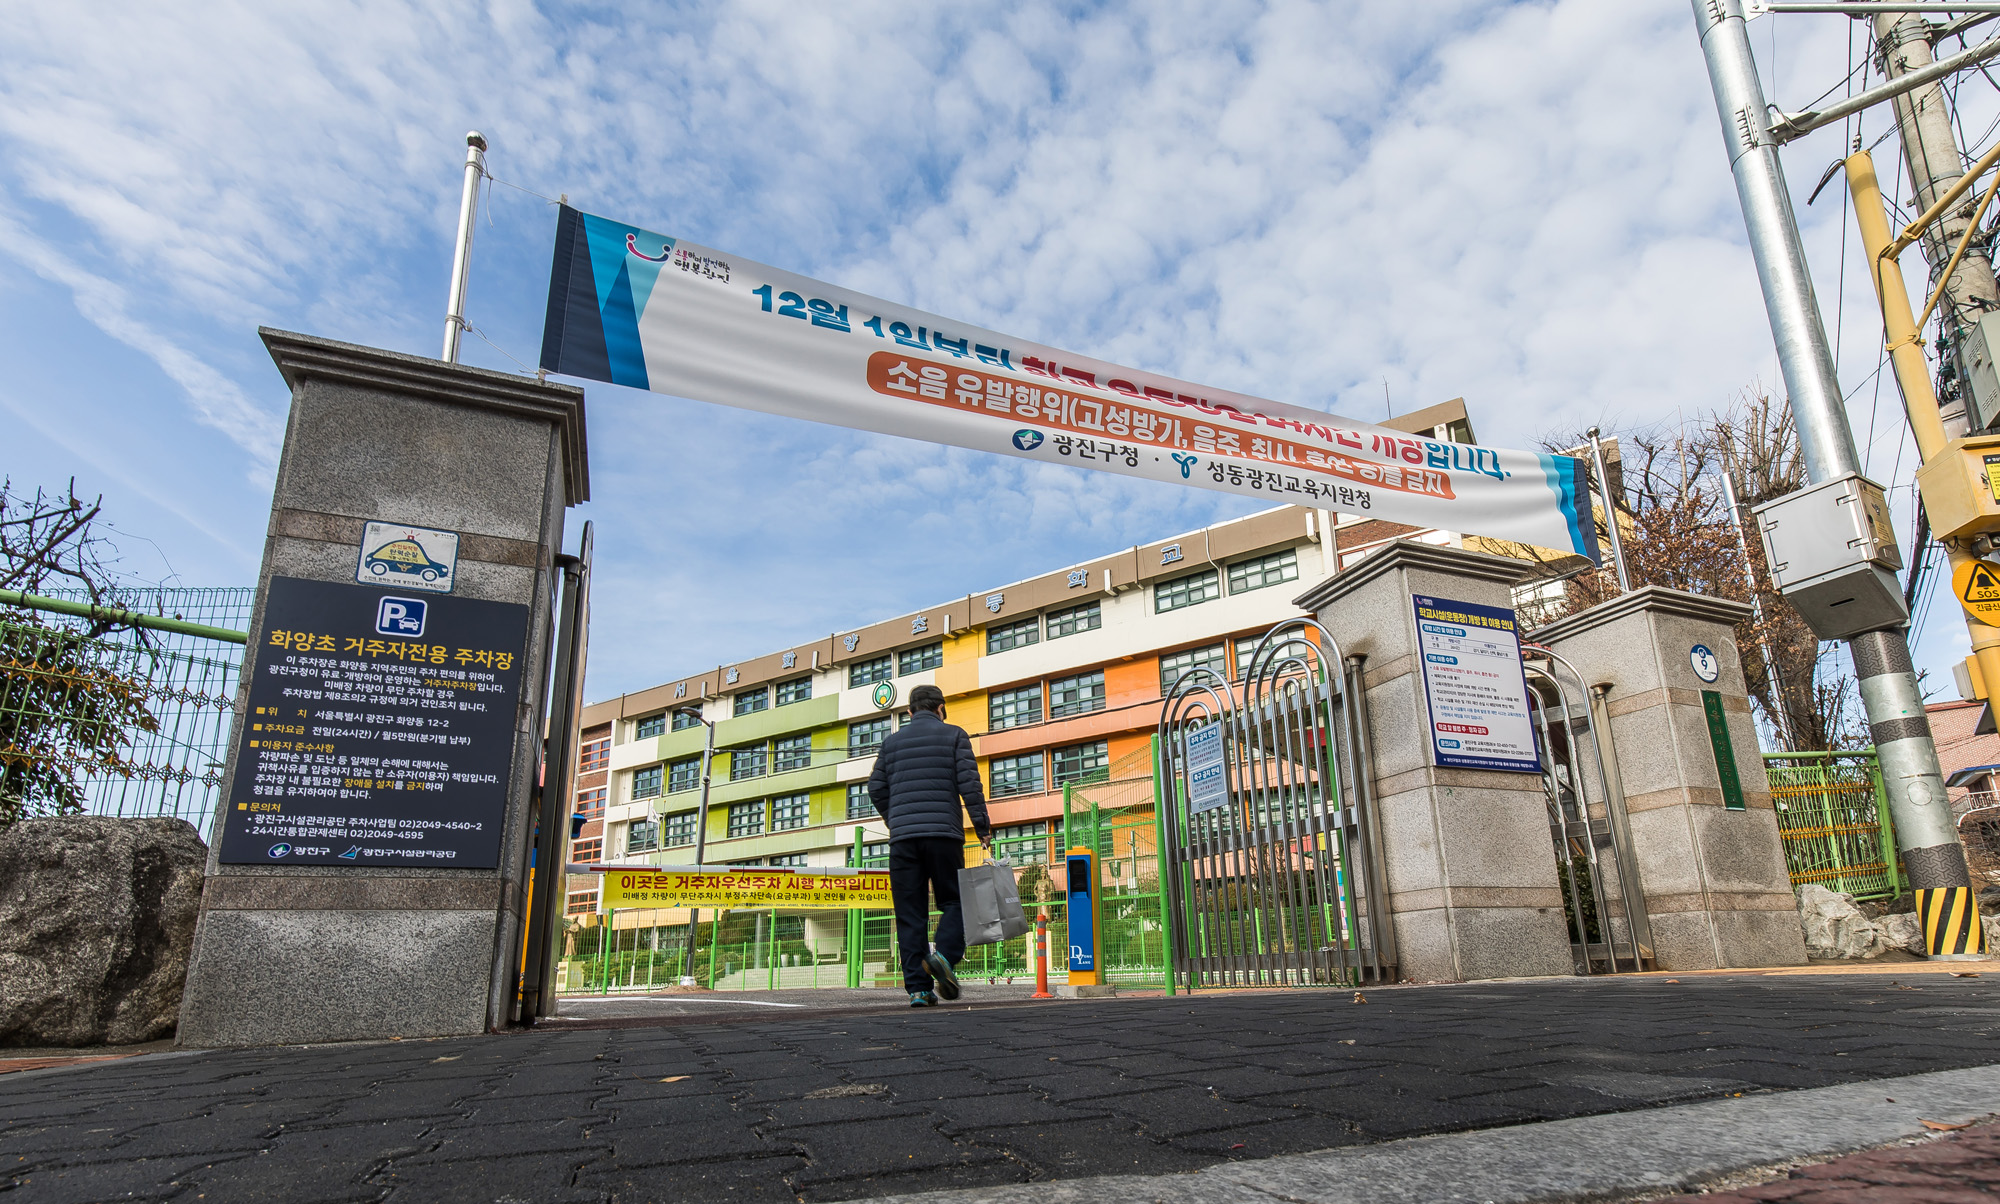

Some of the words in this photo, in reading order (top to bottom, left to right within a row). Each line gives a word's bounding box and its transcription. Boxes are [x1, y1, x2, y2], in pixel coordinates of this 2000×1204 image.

[674, 259, 730, 284] 행복광진
[752, 284, 851, 334] 12월
[886, 361, 948, 400] 소음
[954, 374, 1188, 448] 유발행위(고성방가,
[1193, 425, 1247, 458] 음주,
[1406, 468, 1445, 496] 금지
[1052, 434, 1138, 468] 광진구청
[1208, 461, 1371, 509] 성동광진교육지원청
[1977, 590, 2000, 598] SOS
[381, 602, 407, 628] P
[1488, 618, 1500, 628] 이용
[1501, 620, 1514, 630] 안내
[269, 630, 336, 652] 화양초
[344, 638, 448, 664] 거주자전용
[454, 648, 514, 670] 주차장
[286, 656, 296, 664] 이
[298, 656, 337, 668] 주차장은
[340, 660, 368, 672] 화양동
[371, 663, 416, 675] 지역주민의
[419, 667, 437, 677] 주차
[440, 670, 466, 680] 편의를
[469, 672, 494, 682] 위하여
[1701, 660, 1708, 670] 9
[269, 665, 318, 678] 광진구청이
[385, 675, 421, 686] 운영하는
[424, 679, 505, 693] 거주자주차장입니다.
[324, 680, 352, 692] 미배정
[355, 684, 384, 694] 차량이
[386, 685, 404, 696] 무단
[407, 687, 434, 698] 주차할
[437, 690, 454, 700] 경우
[282, 688, 322, 700] 주차장법
[324, 691, 366, 703] 제8조의2
[369, 695, 398, 706] 규정에
[400, 697, 418, 707] 의거
[420, 699, 456, 710] 견인조치
[459, 702, 488, 712] 됩니다.
[268, 706, 278, 716] 위
[298, 709, 307, 718] 치
[315, 710, 363, 722] 서울특별시
[366, 714, 394, 724] 광진구
[396, 716, 424, 726] 화양동
[428, 720, 450, 728] 12-2
[265, 724, 305, 735] 주차요금
[312, 726, 372, 740] 전일(24시간)
[450, 736, 471, 746] 납부)
[262, 740, 292, 750] 이용자
[295, 742, 334, 754] 준수사항
[260, 751, 300, 762] 차량파손
[304, 754, 312, 763] 및
[315, 754, 335, 764] 도난
[338, 756, 348, 765] 등
[350, 756, 379, 767] 일체의
[382, 758, 410, 768] 손해에
[412, 760, 448, 770] 대해서는
[258, 762, 308, 774] 귀책사유를
[312, 766, 350, 776] 입증하지
[353, 768, 372, 778] 않는
[375, 768, 384, 778] 한
[386, 770, 449, 782] 소유자(이용자)
[452, 772, 500, 784] 책임입니다.
[253, 785, 284, 796] 청결을
[286, 786, 337, 798] 유지하여야
[340, 789, 372, 800] 합니다.
[255, 774, 286, 784] 주차장
[289, 776, 300, 785] 내
[302, 776, 341, 787] 불필요한
[344, 778, 373, 788] 장애물
[376, 780, 404, 790] 설치를
[406, 781, 444, 792] 금지하며
[250, 802, 281, 812] 문의처
[254, 814, 346, 826] 광진구시설관리공단
[348, 818, 396, 828] 주차사업팀
[399, 820, 482, 830] 02)2049-4540~2
[252, 826, 348, 838] 24시간통합관제센터
[350, 830, 424, 840] 02)2049-4595
[294, 846, 330, 856] 광진구
[621, 876, 668, 890] 이곳은
[675, 876, 781, 890] 거주자우선주차
[786, 877, 814, 890] 시행
[820, 878, 892, 890] 지역입니다.
[622, 892, 648, 900] 미배정
[652, 892, 677, 900] 차량이
[680, 892, 722, 900] 무단주차시
